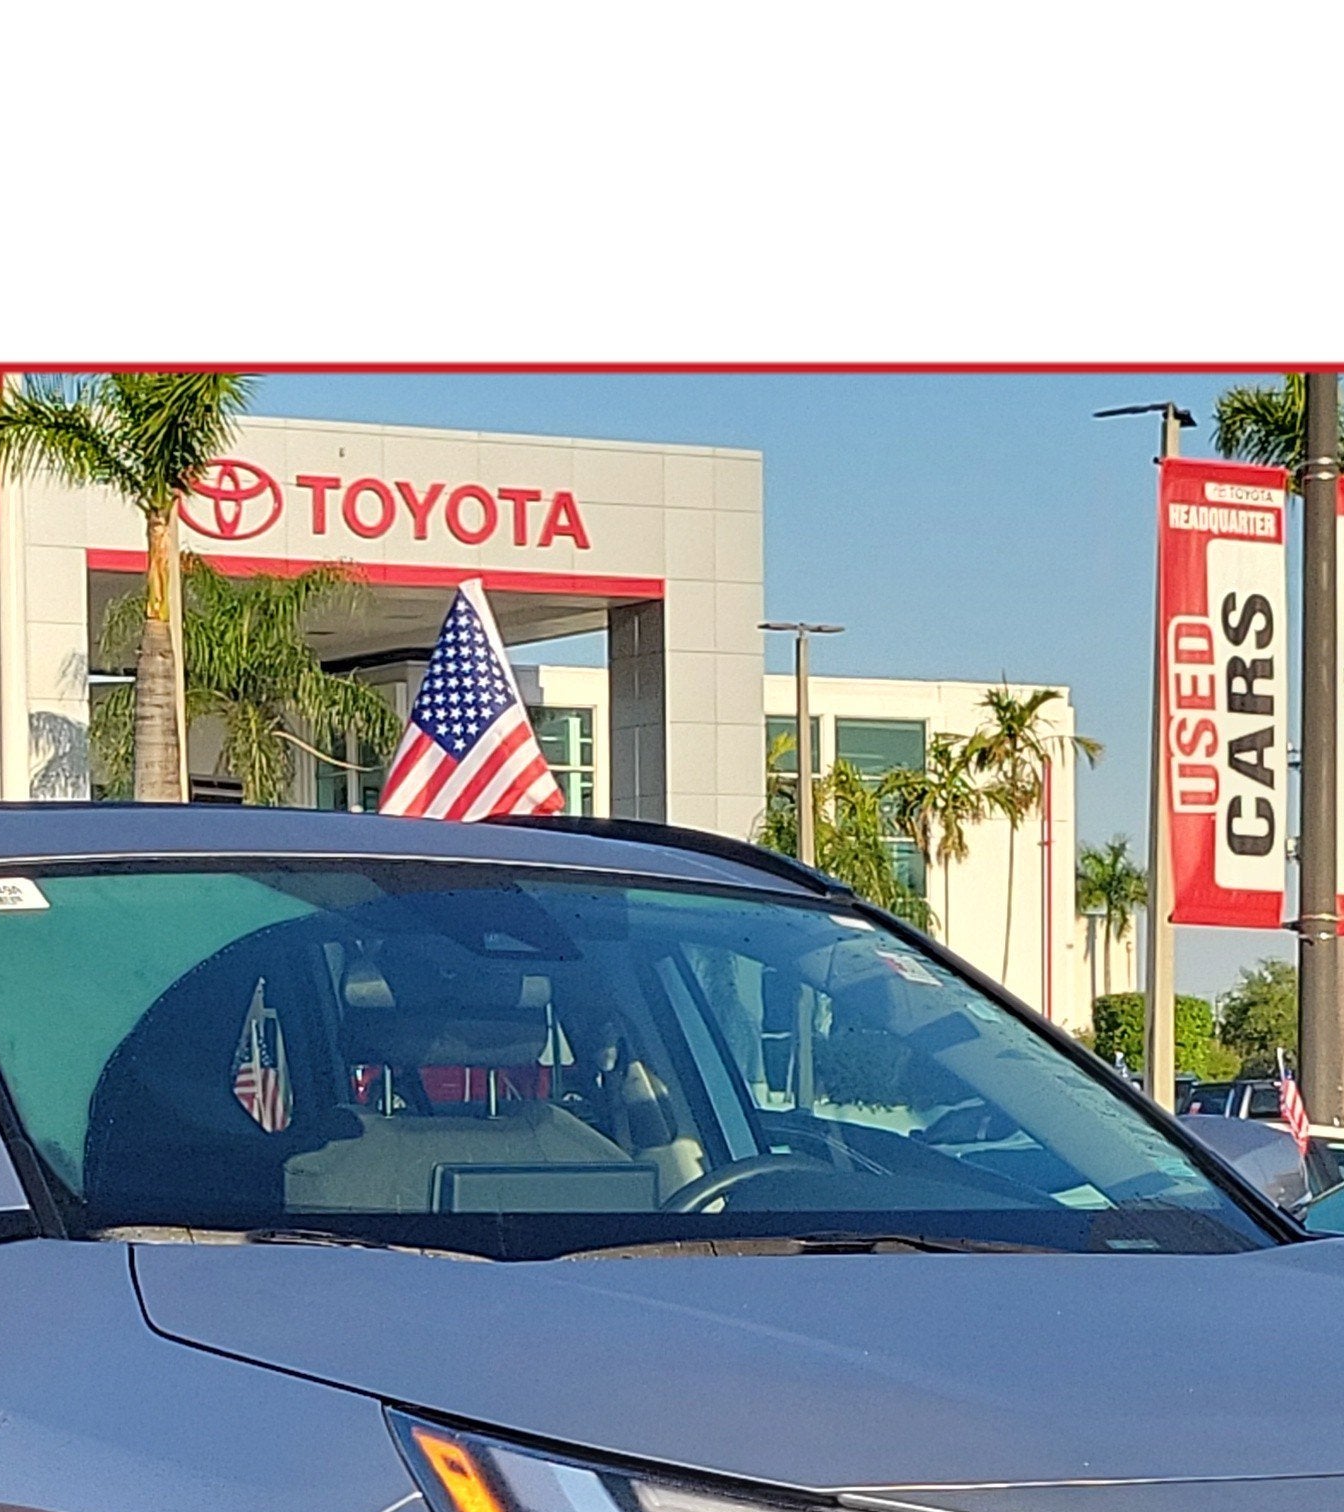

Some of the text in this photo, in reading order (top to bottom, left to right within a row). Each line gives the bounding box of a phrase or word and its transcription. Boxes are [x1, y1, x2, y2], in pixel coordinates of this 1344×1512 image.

[295, 474, 591, 550] TOYOTA
[1168, 502, 1276, 538] HEADQUARTER
[1229, 486, 1274, 503] TOYOTA
[1173, 621, 1220, 807] USED
[1221, 591, 1275, 858] CARS
